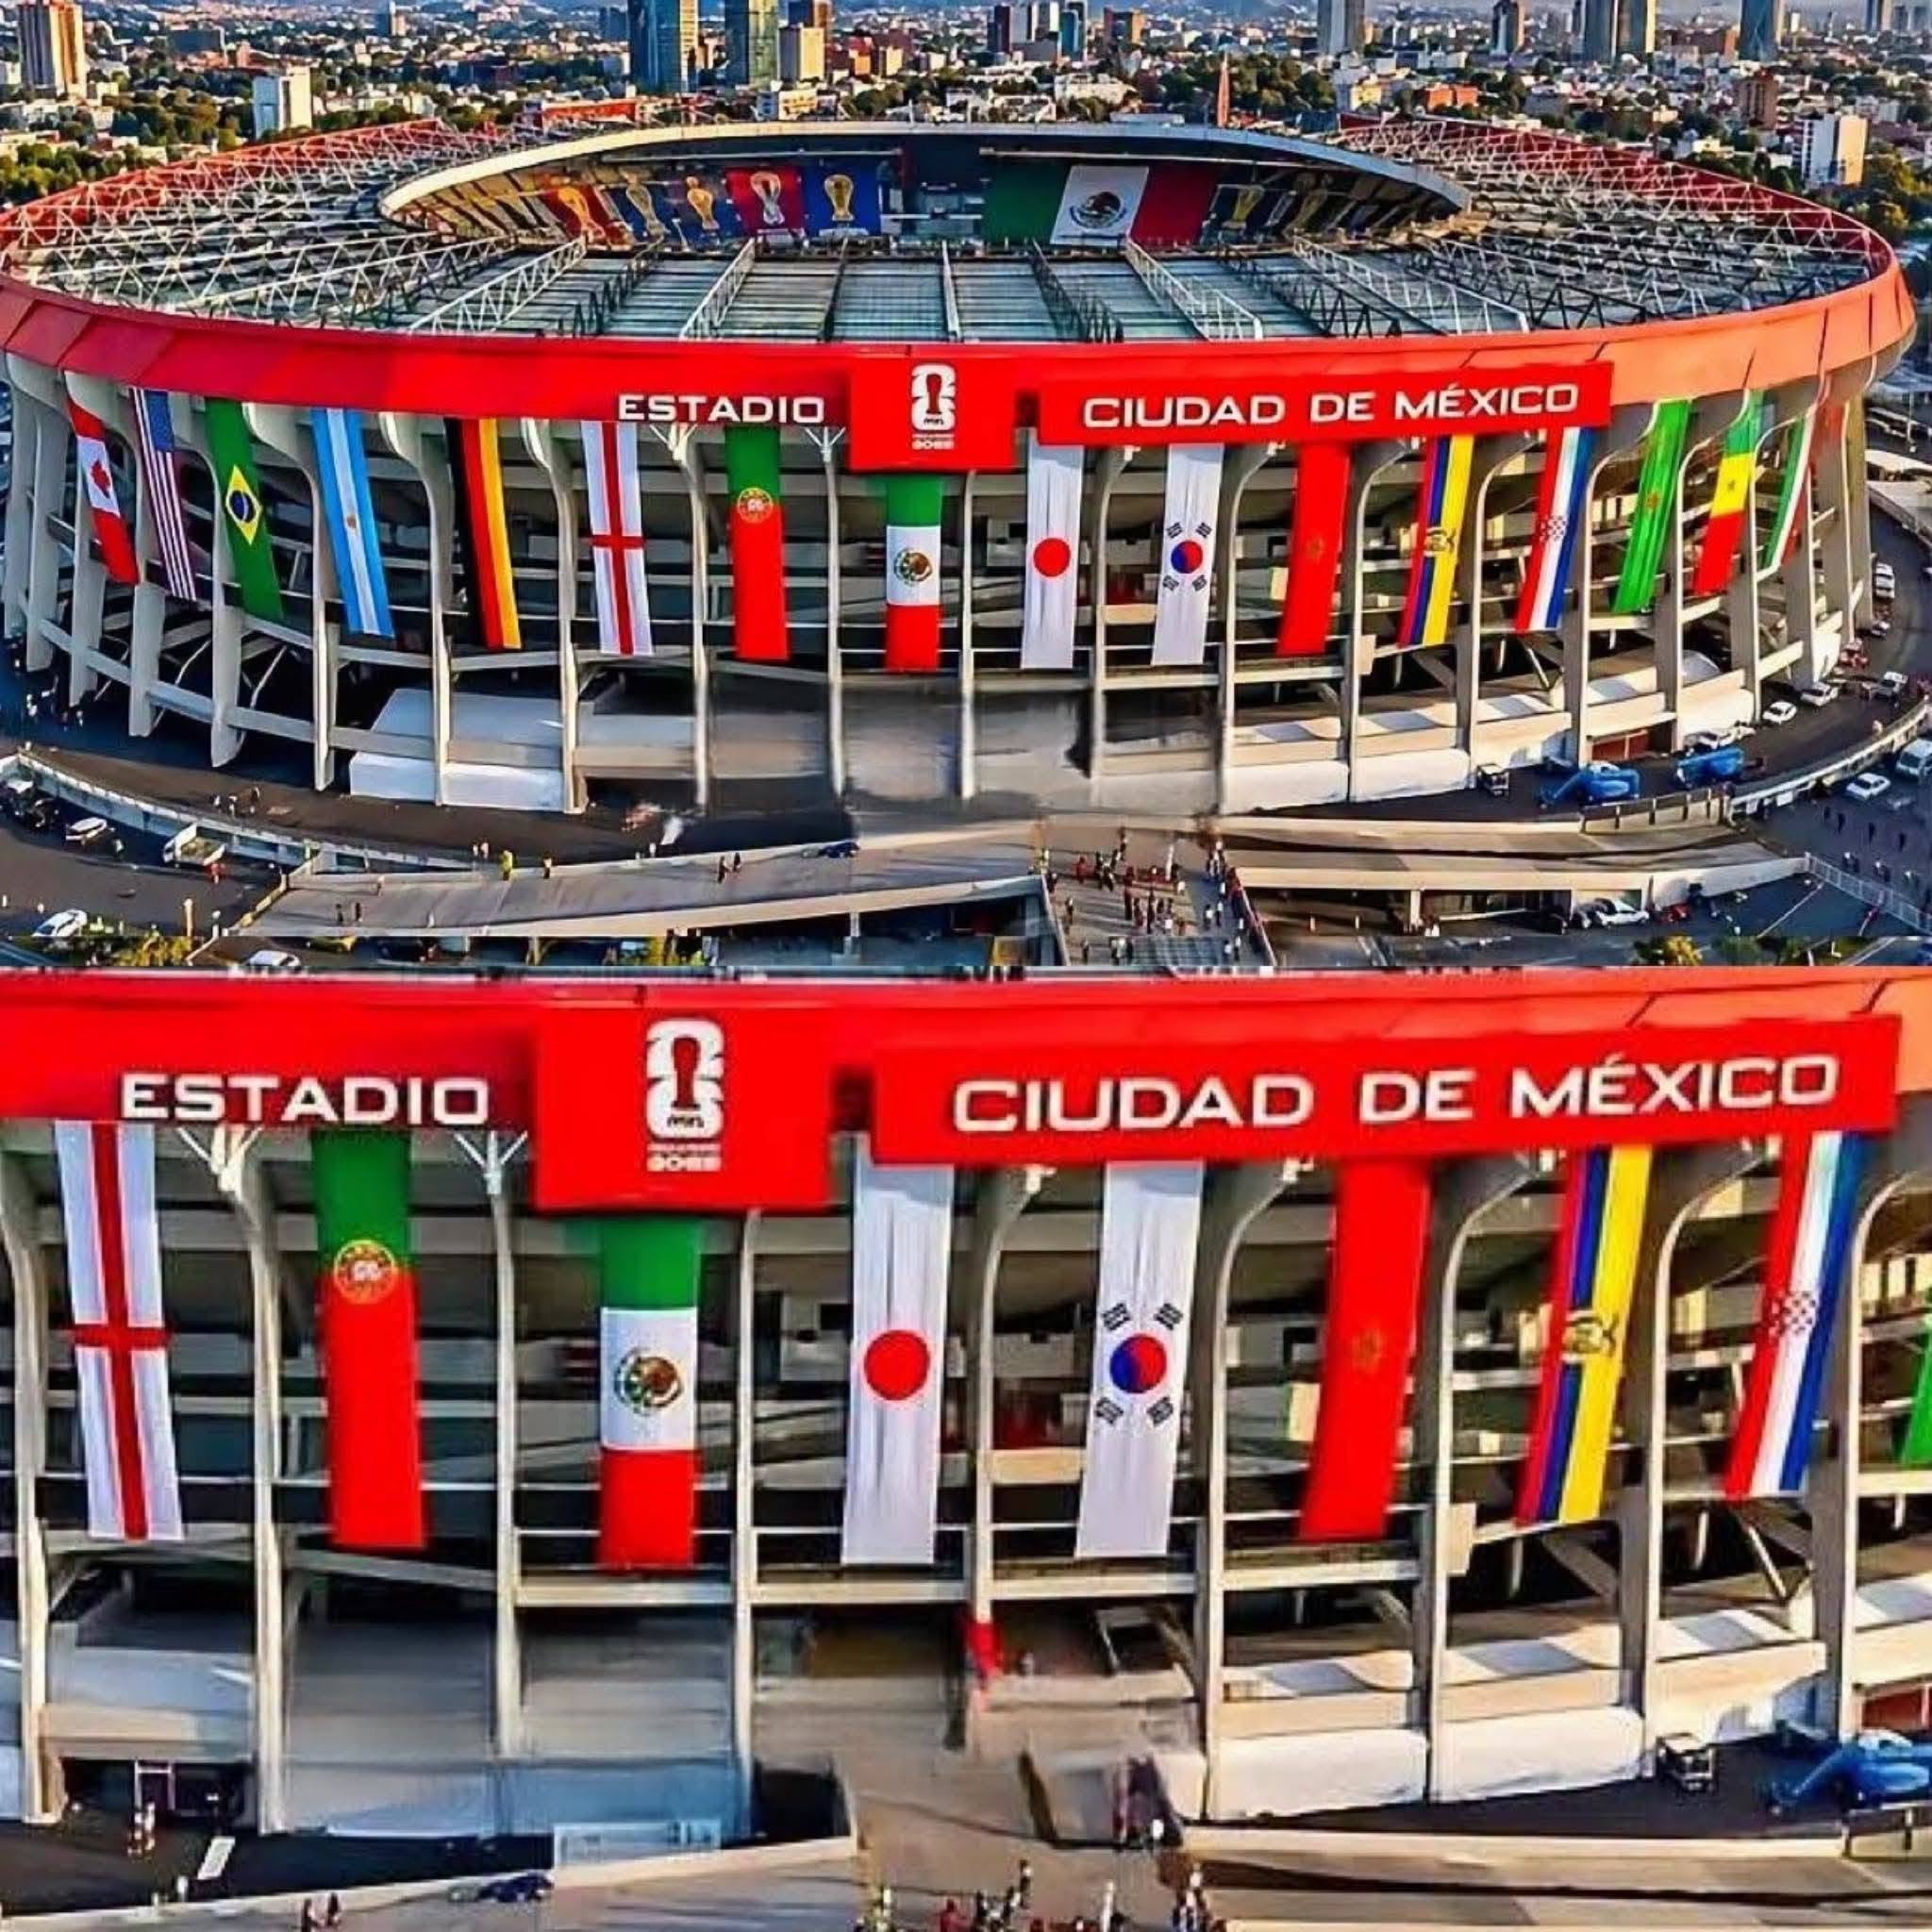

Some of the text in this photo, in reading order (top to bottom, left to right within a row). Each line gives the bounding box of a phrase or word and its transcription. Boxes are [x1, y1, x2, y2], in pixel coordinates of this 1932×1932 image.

[616, 393, 825, 424] ESTADIO
[1082, 382, 1580, 428] CIUDAD DE MÉXICO
[119, 1073, 490, 1126] ESTADIO
[954, 1053, 1840, 1133] CIUDAD DE MÉXICO
